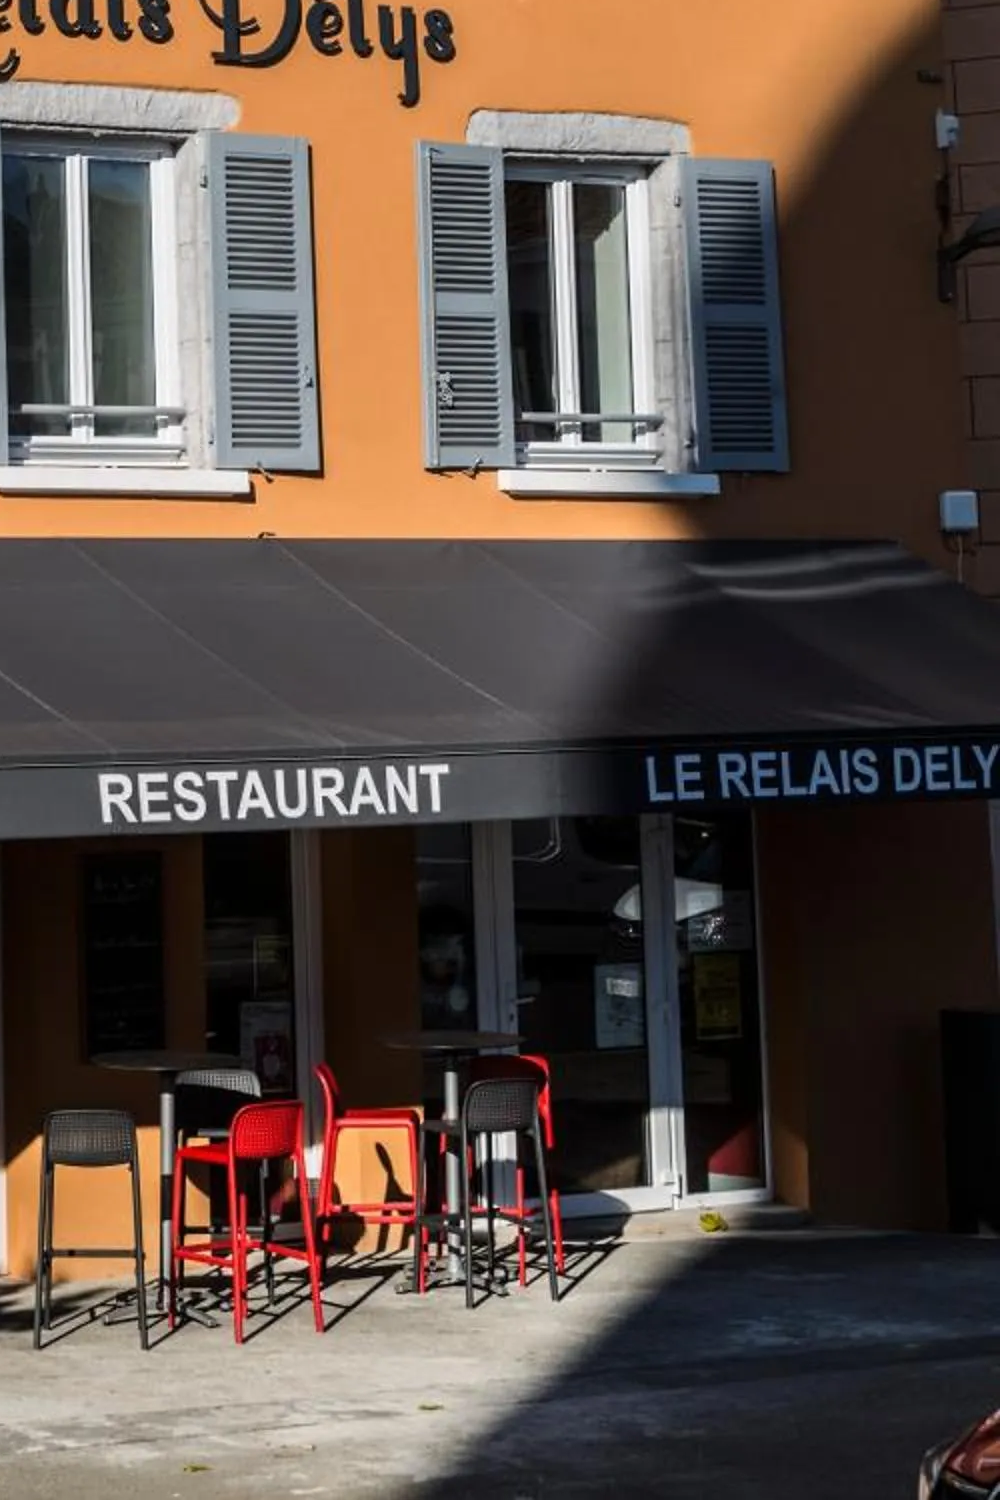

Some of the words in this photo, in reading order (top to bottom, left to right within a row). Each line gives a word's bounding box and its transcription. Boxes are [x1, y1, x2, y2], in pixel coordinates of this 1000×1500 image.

[97, 763, 451, 824] RESTAURANT
[646, 754, 707, 803] LE
[719, 746, 881, 799] RELAIS
